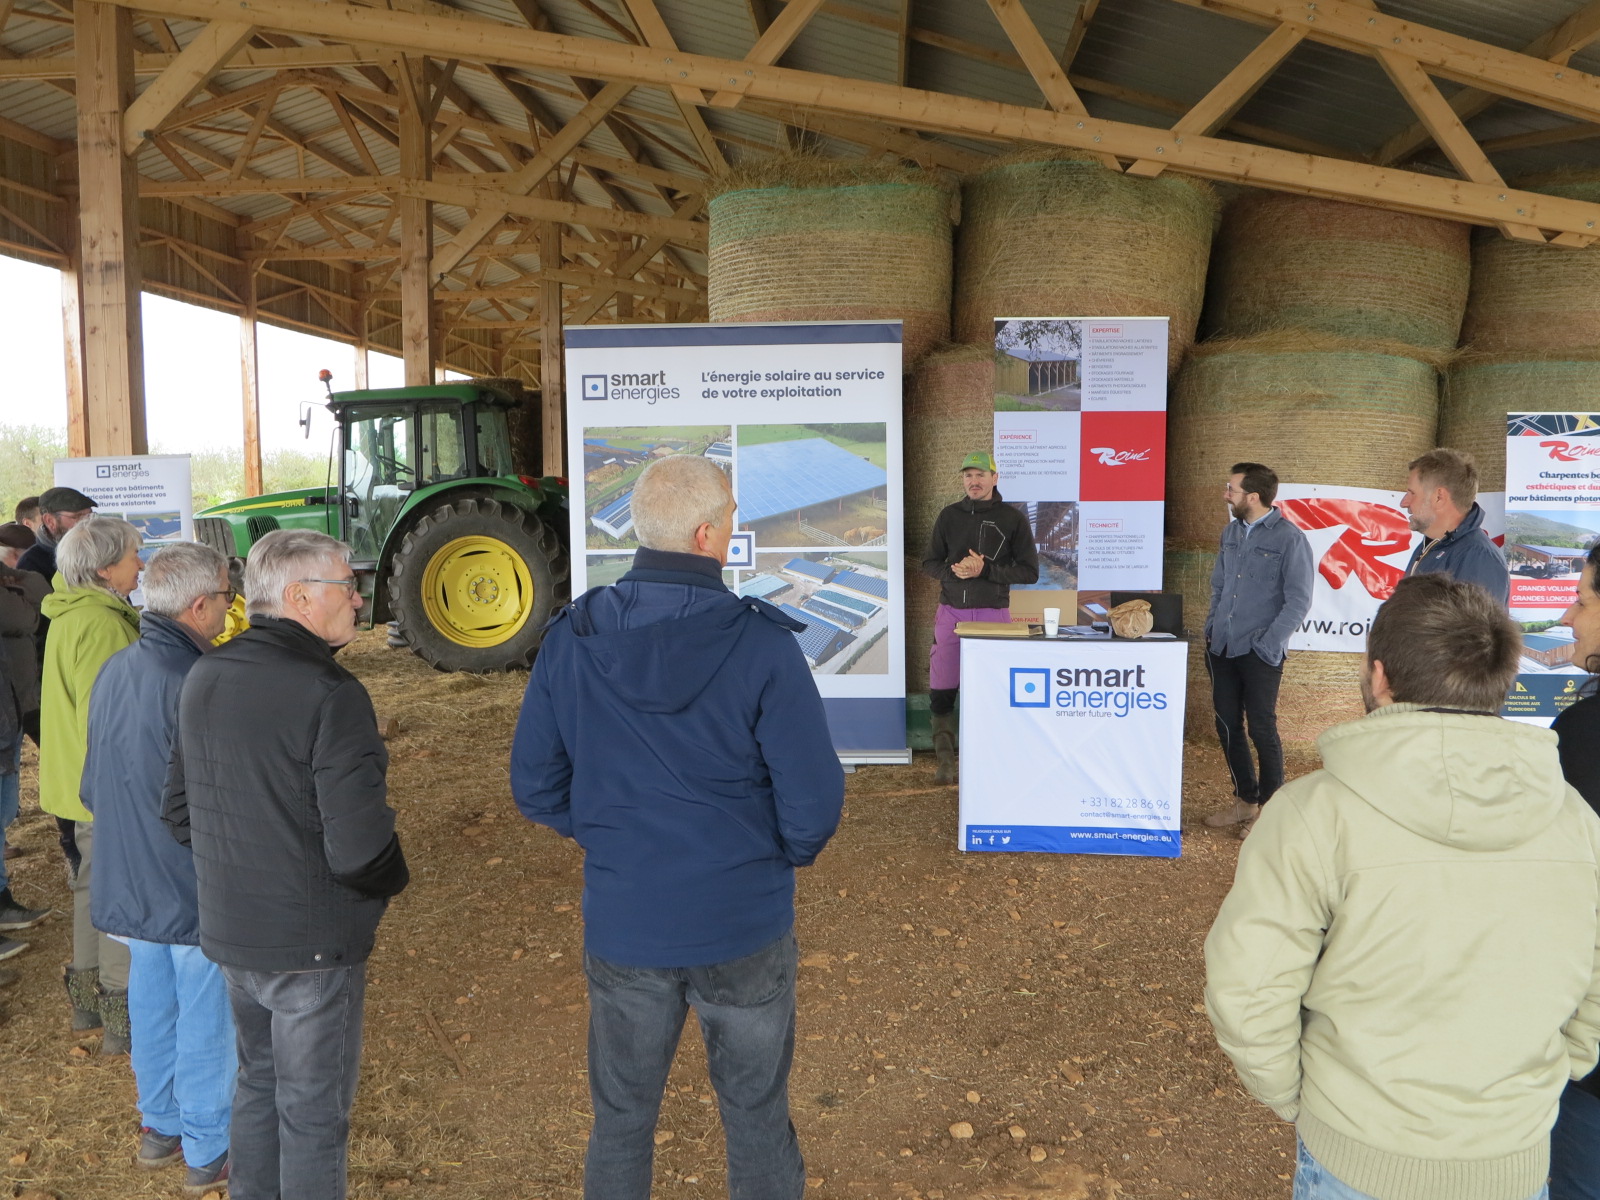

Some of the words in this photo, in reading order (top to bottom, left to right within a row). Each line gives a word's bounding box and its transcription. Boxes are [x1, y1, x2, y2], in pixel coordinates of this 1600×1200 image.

[611, 370, 666, 386] smart
[701, 371, 762, 385] L’énergie
[764, 370, 811, 382] solaire
[814, 372, 832, 381] au
[835, 368, 884, 380] service
[611, 384, 680, 404] energies
[701, 388, 718, 400] de
[722, 388, 758, 399] votre
[760, 386, 842, 401] exploitation
[1090, 447, 1150, 466] Roiné
[112, 462, 142, 470] smart
[112, 470, 150, 480] energies
[1539, 471, 1589, 480] Charpentes
[1056, 665, 1145, 688] smart
[1056, 687, 1167, 717] energies
[1088, 710, 1112, 718] future
[1111, 798, 1123, 808] 82
[1126, 798, 1138, 808] 28
[1140, 799, 1154, 809] 86
[1157, 800, 1170, 810] 96
[1080, 812, 1171, 821] contact@smart-energies.eu
[1070, 831, 1172, 843] www.smart-energies.eu
